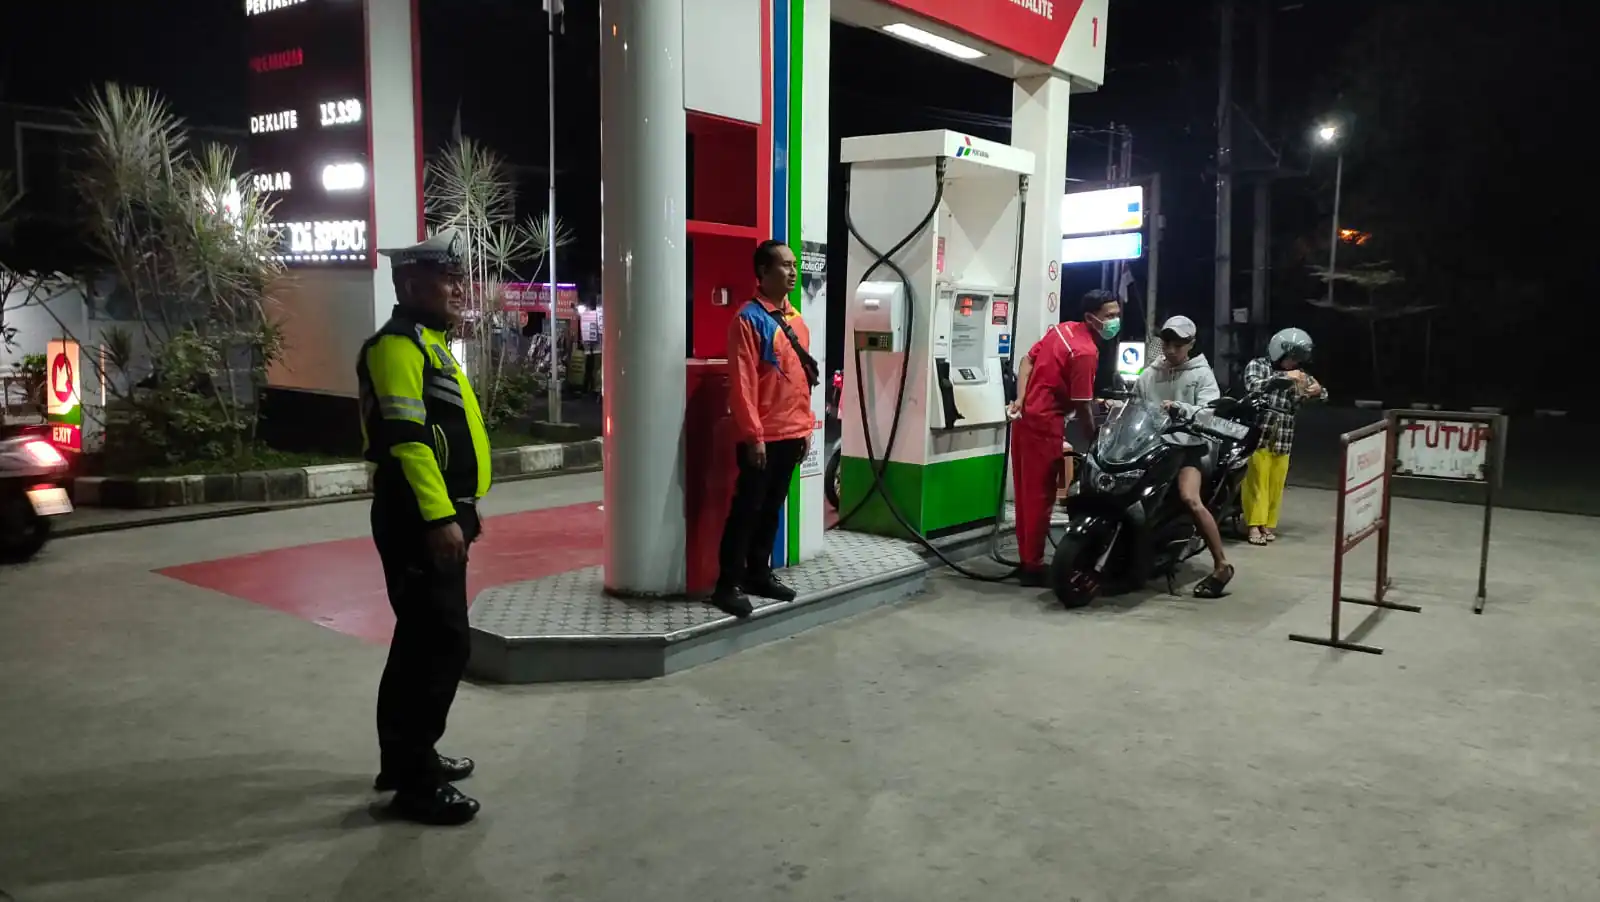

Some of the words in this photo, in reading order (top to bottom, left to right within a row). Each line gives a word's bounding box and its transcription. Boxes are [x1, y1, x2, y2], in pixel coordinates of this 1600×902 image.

[245, 0, 305, 16] PERTA
[1092, 17, 1098, 47] 1
[250, 110, 297, 134] DEXLITE
[253, 171, 292, 192] SOLAR
[52, 426, 72, 444] EXIT
[1404, 420, 1493, 453] TUTUP
